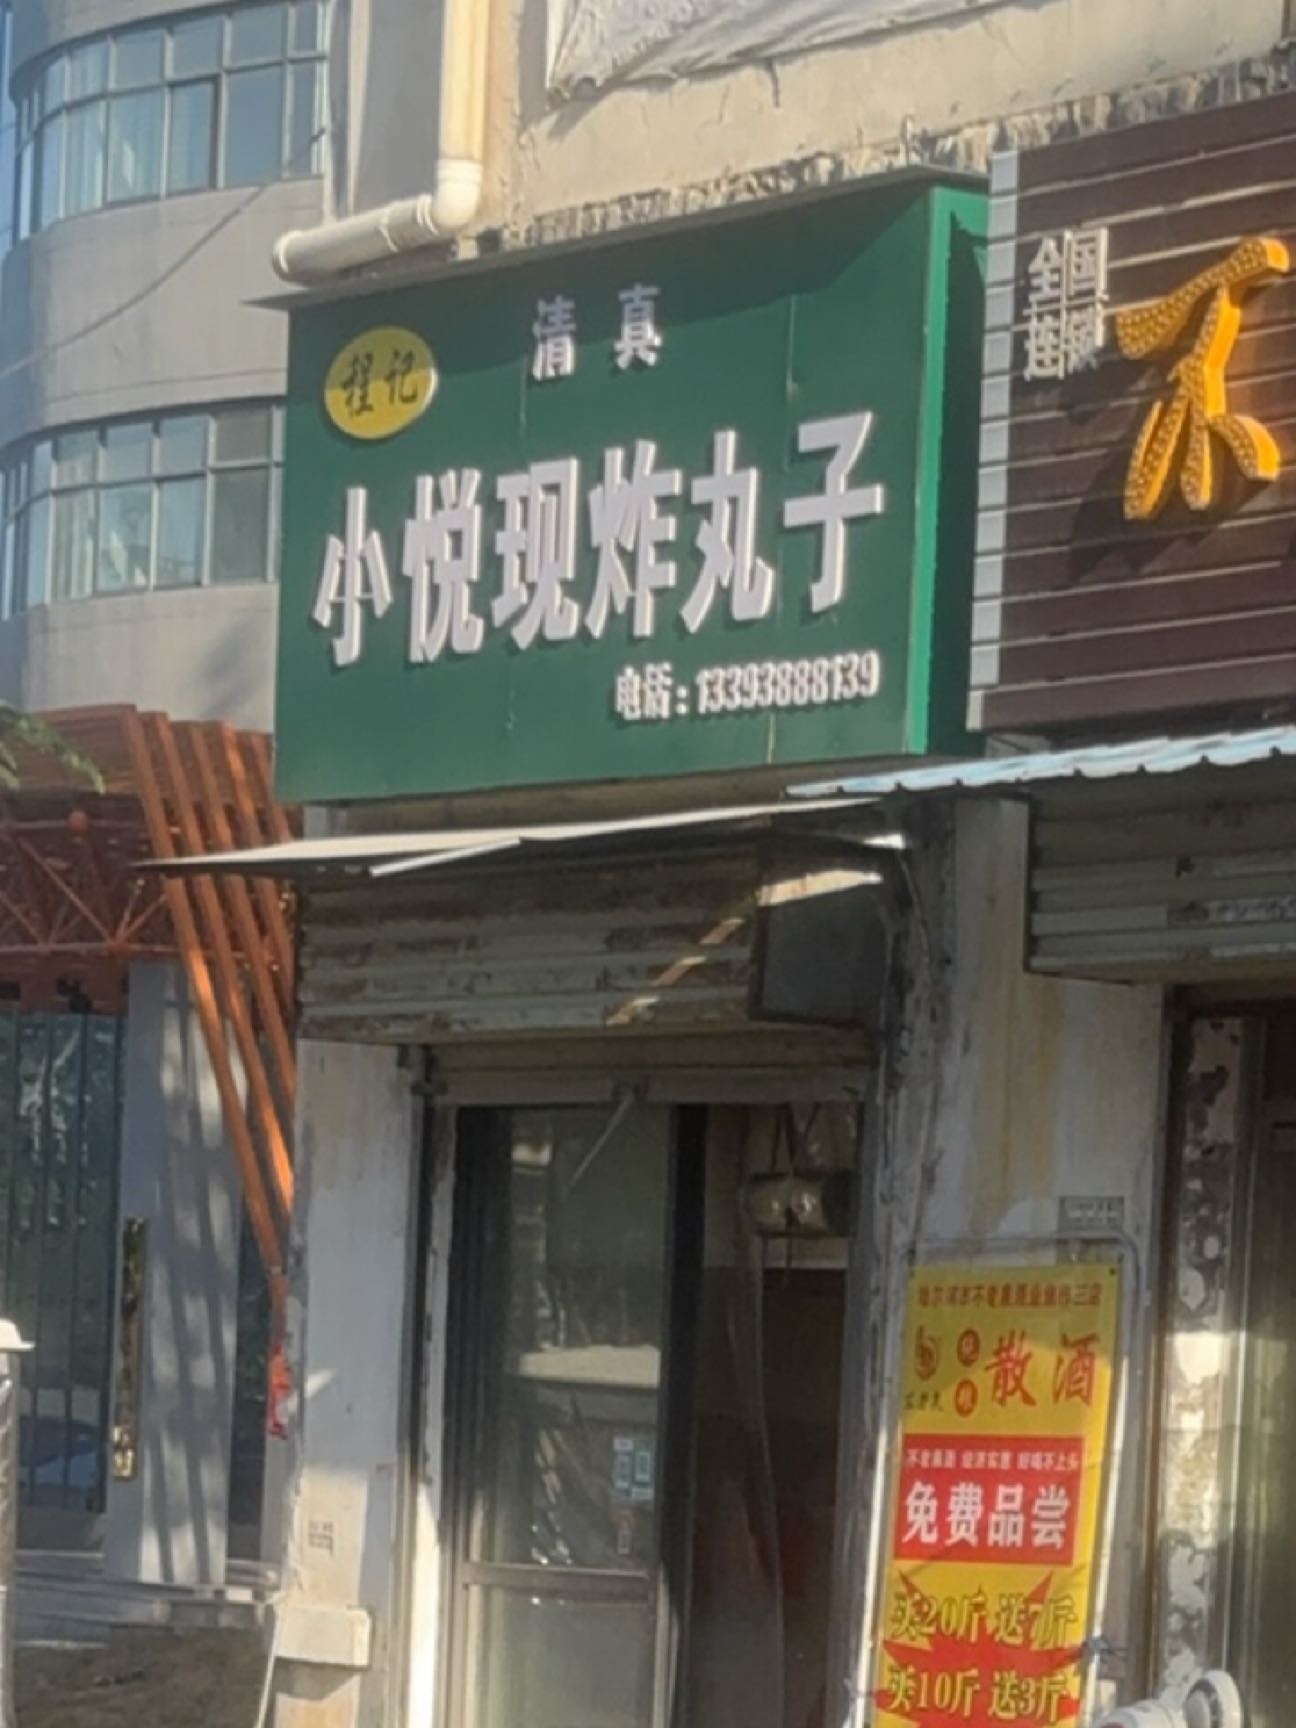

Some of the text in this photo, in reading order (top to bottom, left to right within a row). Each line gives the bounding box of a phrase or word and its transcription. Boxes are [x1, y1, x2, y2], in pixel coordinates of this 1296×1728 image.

[1027, 227, 1109, 303] 全国
[531, 284, 662, 381] 清真
[312, 410, 885, 667] 小悦现炸丸子
[984, 1328, 1101, 1408] 散酒
[902, 1480, 1070, 1550] 免费品尝
[890, 1590, 1079, 1648] 买20斤 送7斤
[888, 1664, 1068, 1724] 买10斤 送3斤
